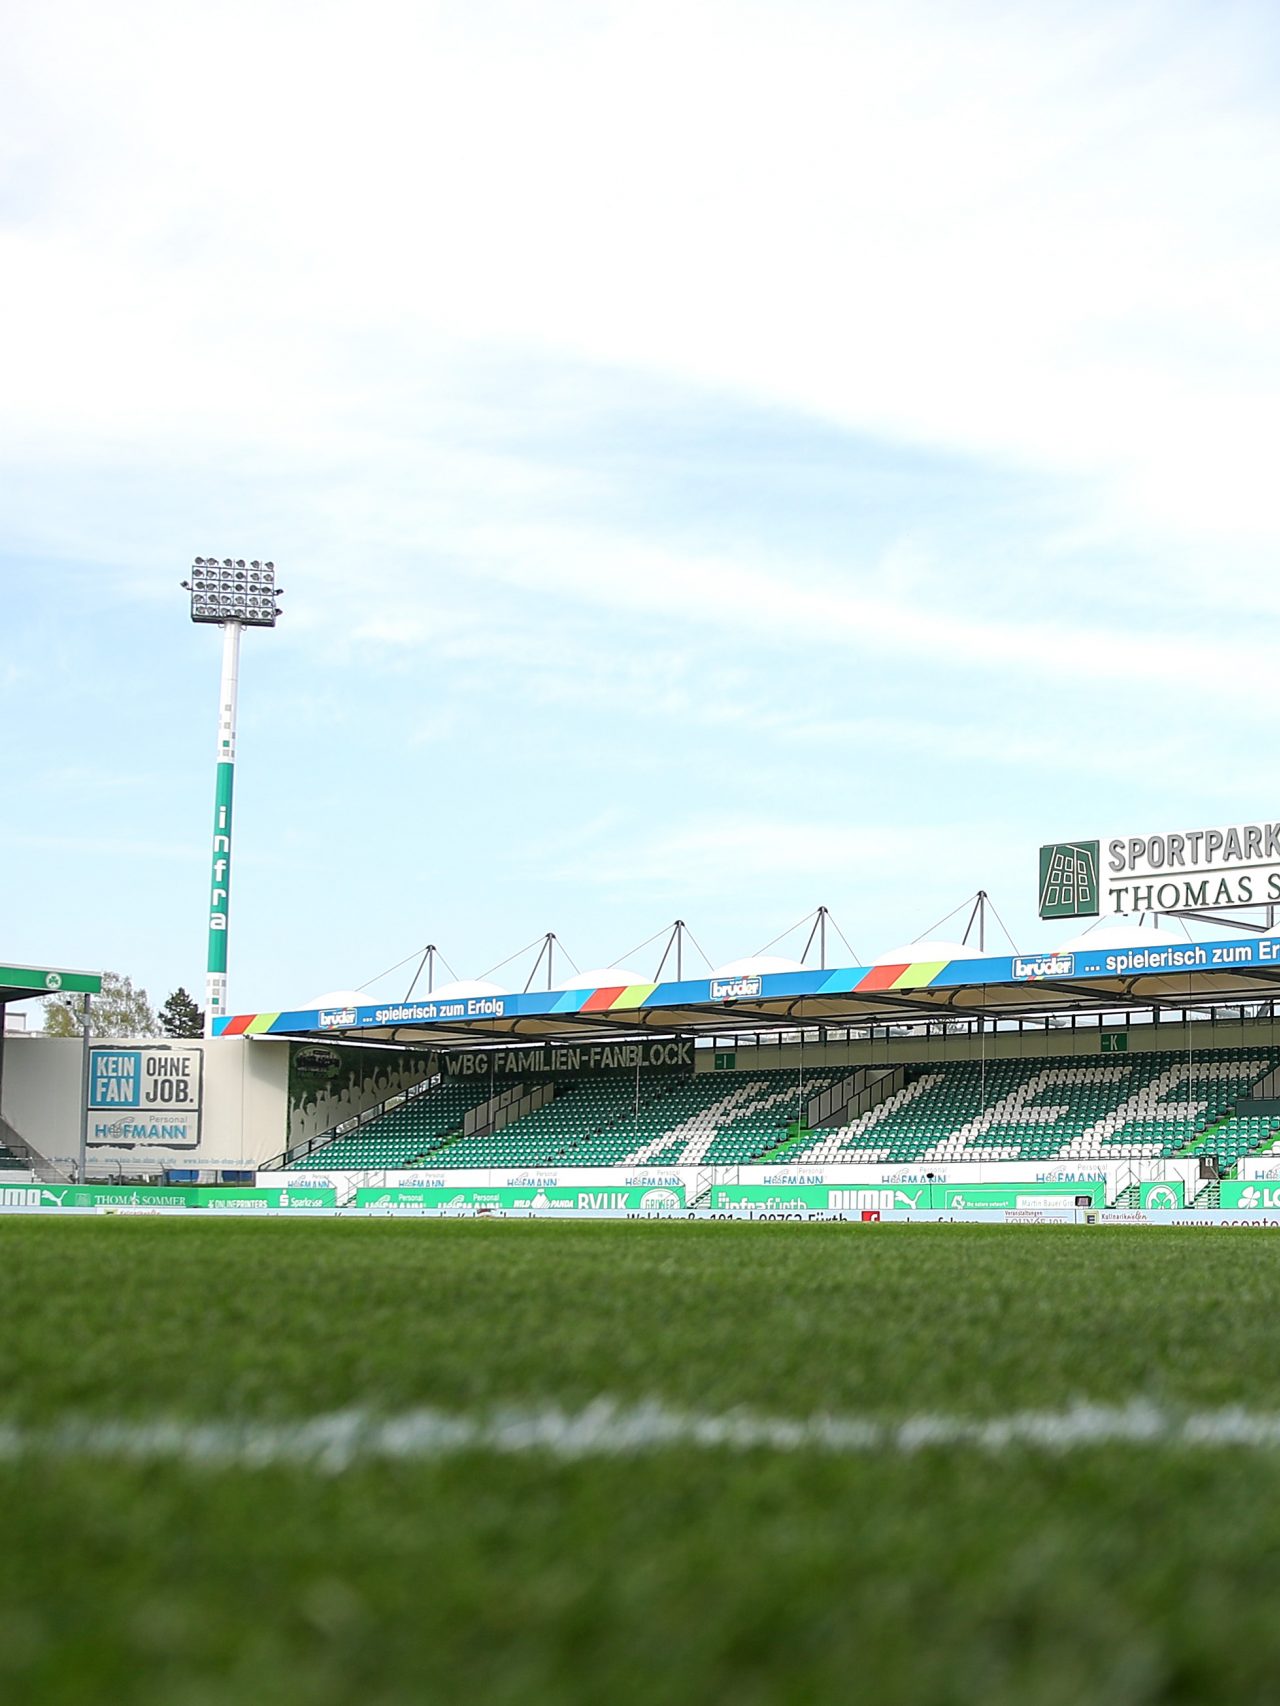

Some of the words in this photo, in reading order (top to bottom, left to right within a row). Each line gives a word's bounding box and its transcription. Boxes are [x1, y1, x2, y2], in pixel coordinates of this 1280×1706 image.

[209, 805, 229, 930] infra
[1108, 876, 1253, 914] THOMAS
[1106, 946, 1206, 974] spielerisch
[1212, 945, 1252, 963] zum
[375, 1004, 437, 1024] spielerisch
[440, 1004, 464, 1017] zum
[467, 998, 504, 1016] Erfolg
[1110, 1034, 1118, 1051] K
[97, 1057, 135, 1077] KEIN
[147, 1057, 191, 1077] OHNE
[446, 1053, 488, 1075] WBG
[494, 1042, 693, 1073] FAMILIEN-FANBLOCK
[96, 1078, 134, 1102] FAN
[145, 1079, 194, 1103] JOB.
[149, 1115, 188, 1124] Personal
[95, 1195, 139, 1205] THOMAS
[142, 1197, 187, 1206] SOMMER
[290, 1197, 323, 1208] Sparkasse
